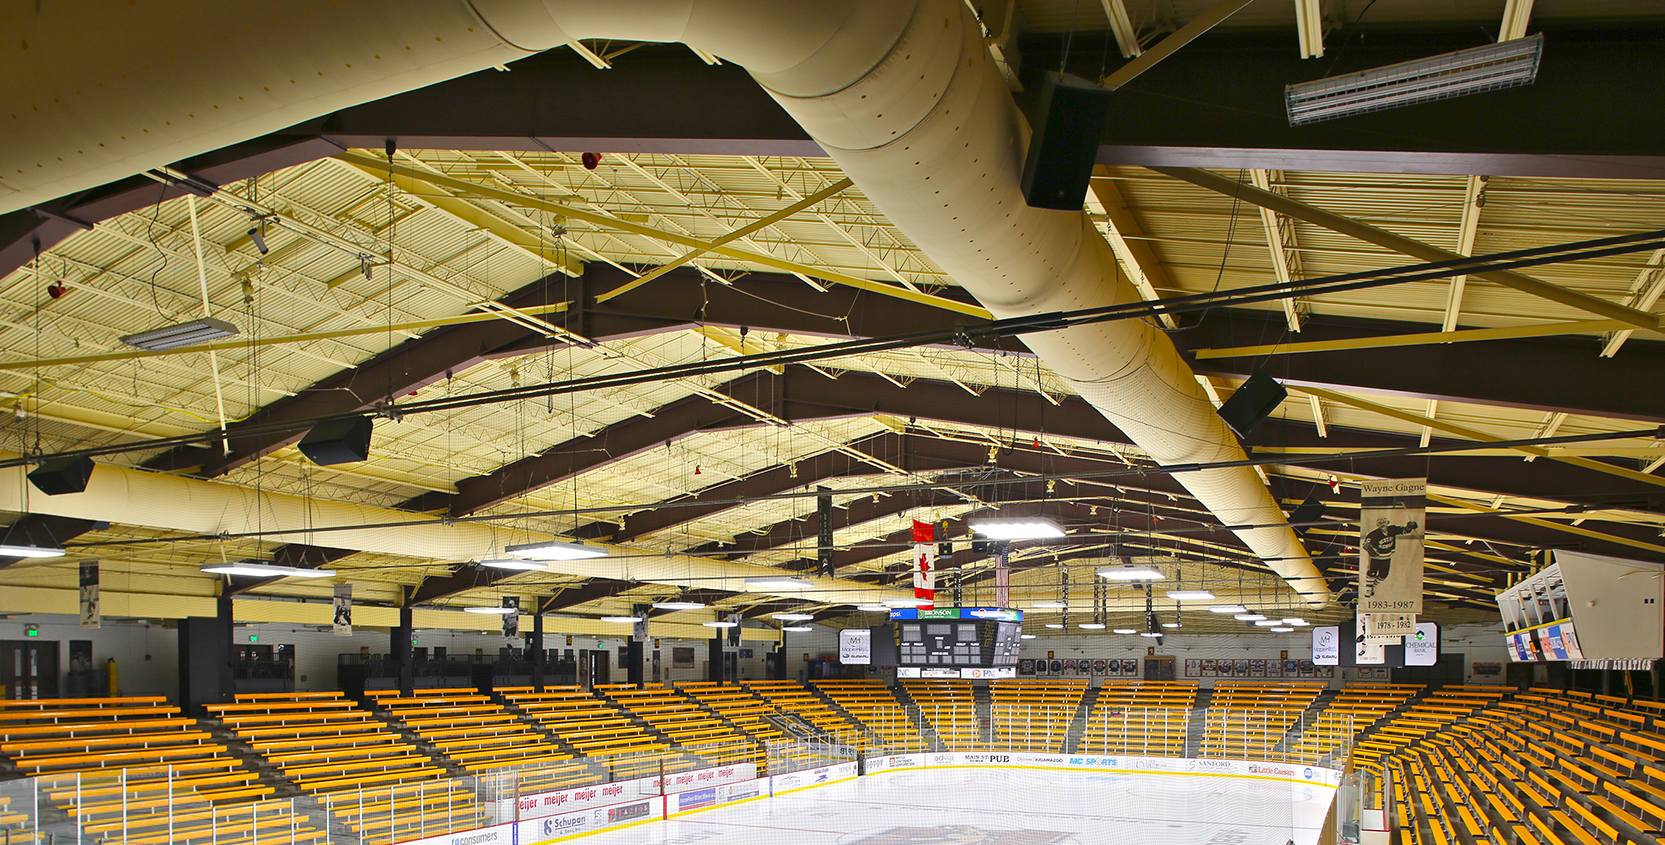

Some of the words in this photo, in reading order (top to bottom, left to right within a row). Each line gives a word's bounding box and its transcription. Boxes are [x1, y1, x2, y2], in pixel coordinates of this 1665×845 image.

[1363, 484, 1393, 494] Wayne
[1395, 483, 1425, 493] Gagne
[1368, 601, 1414, 609] 1983-1987
[1377, 621, 1391, 629] 1978
[1397, 621, 1411, 629] 1982
[1612, 660, 1652, 670] LUNATICS
[1258, 766, 1273, 774] Little
[1274, 768, 1295, 776] Caesars
[653, 777, 672, 788] meer
[520, 797, 538, 812] eijer
[544, 792, 569, 806] meijer
[575, 788, 597, 801] meijer
[602, 784, 623, 797] meijer
[554, 816, 586, 828] Schupan
[461, 832, 498, 845] consumers
